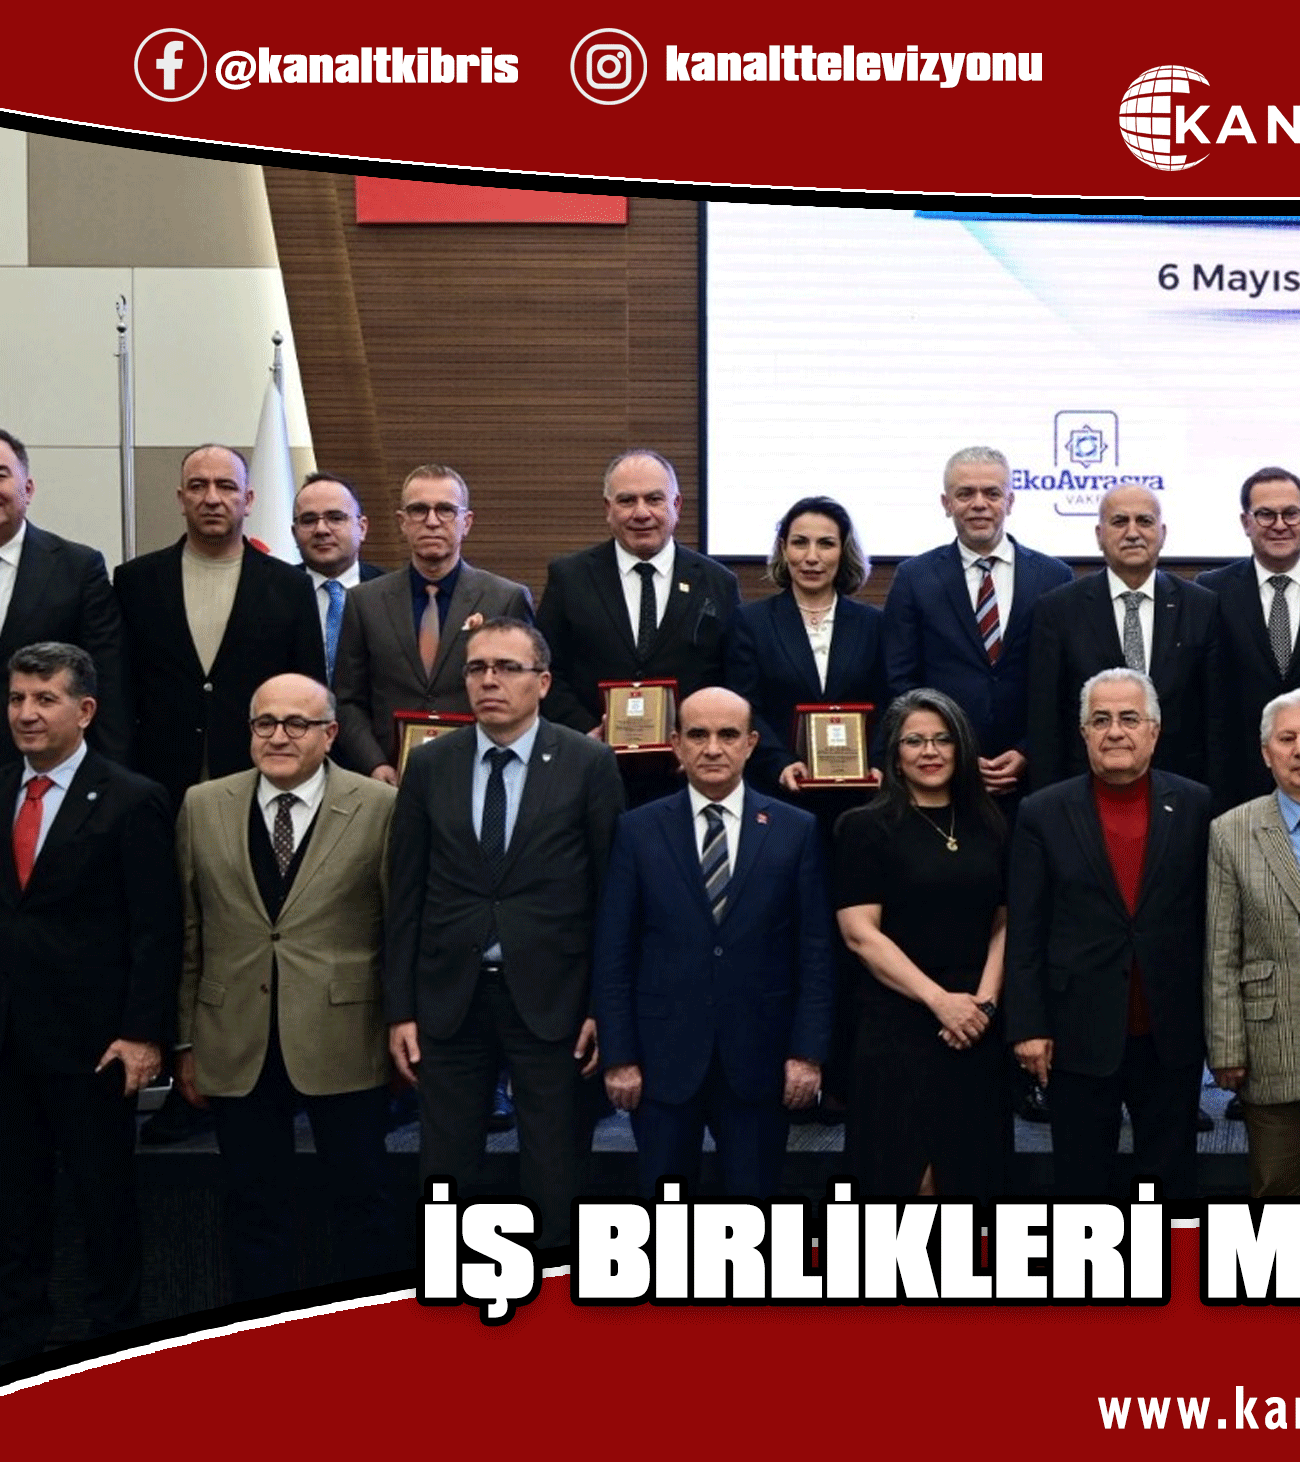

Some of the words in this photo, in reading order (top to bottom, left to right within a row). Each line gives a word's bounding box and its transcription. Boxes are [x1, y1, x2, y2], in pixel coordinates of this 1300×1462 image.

[1158, 264, 1180, 292] 6
[1193, 264, 1300, 299] Mayıs
[1065, 494, 1103, 505] VAKF
